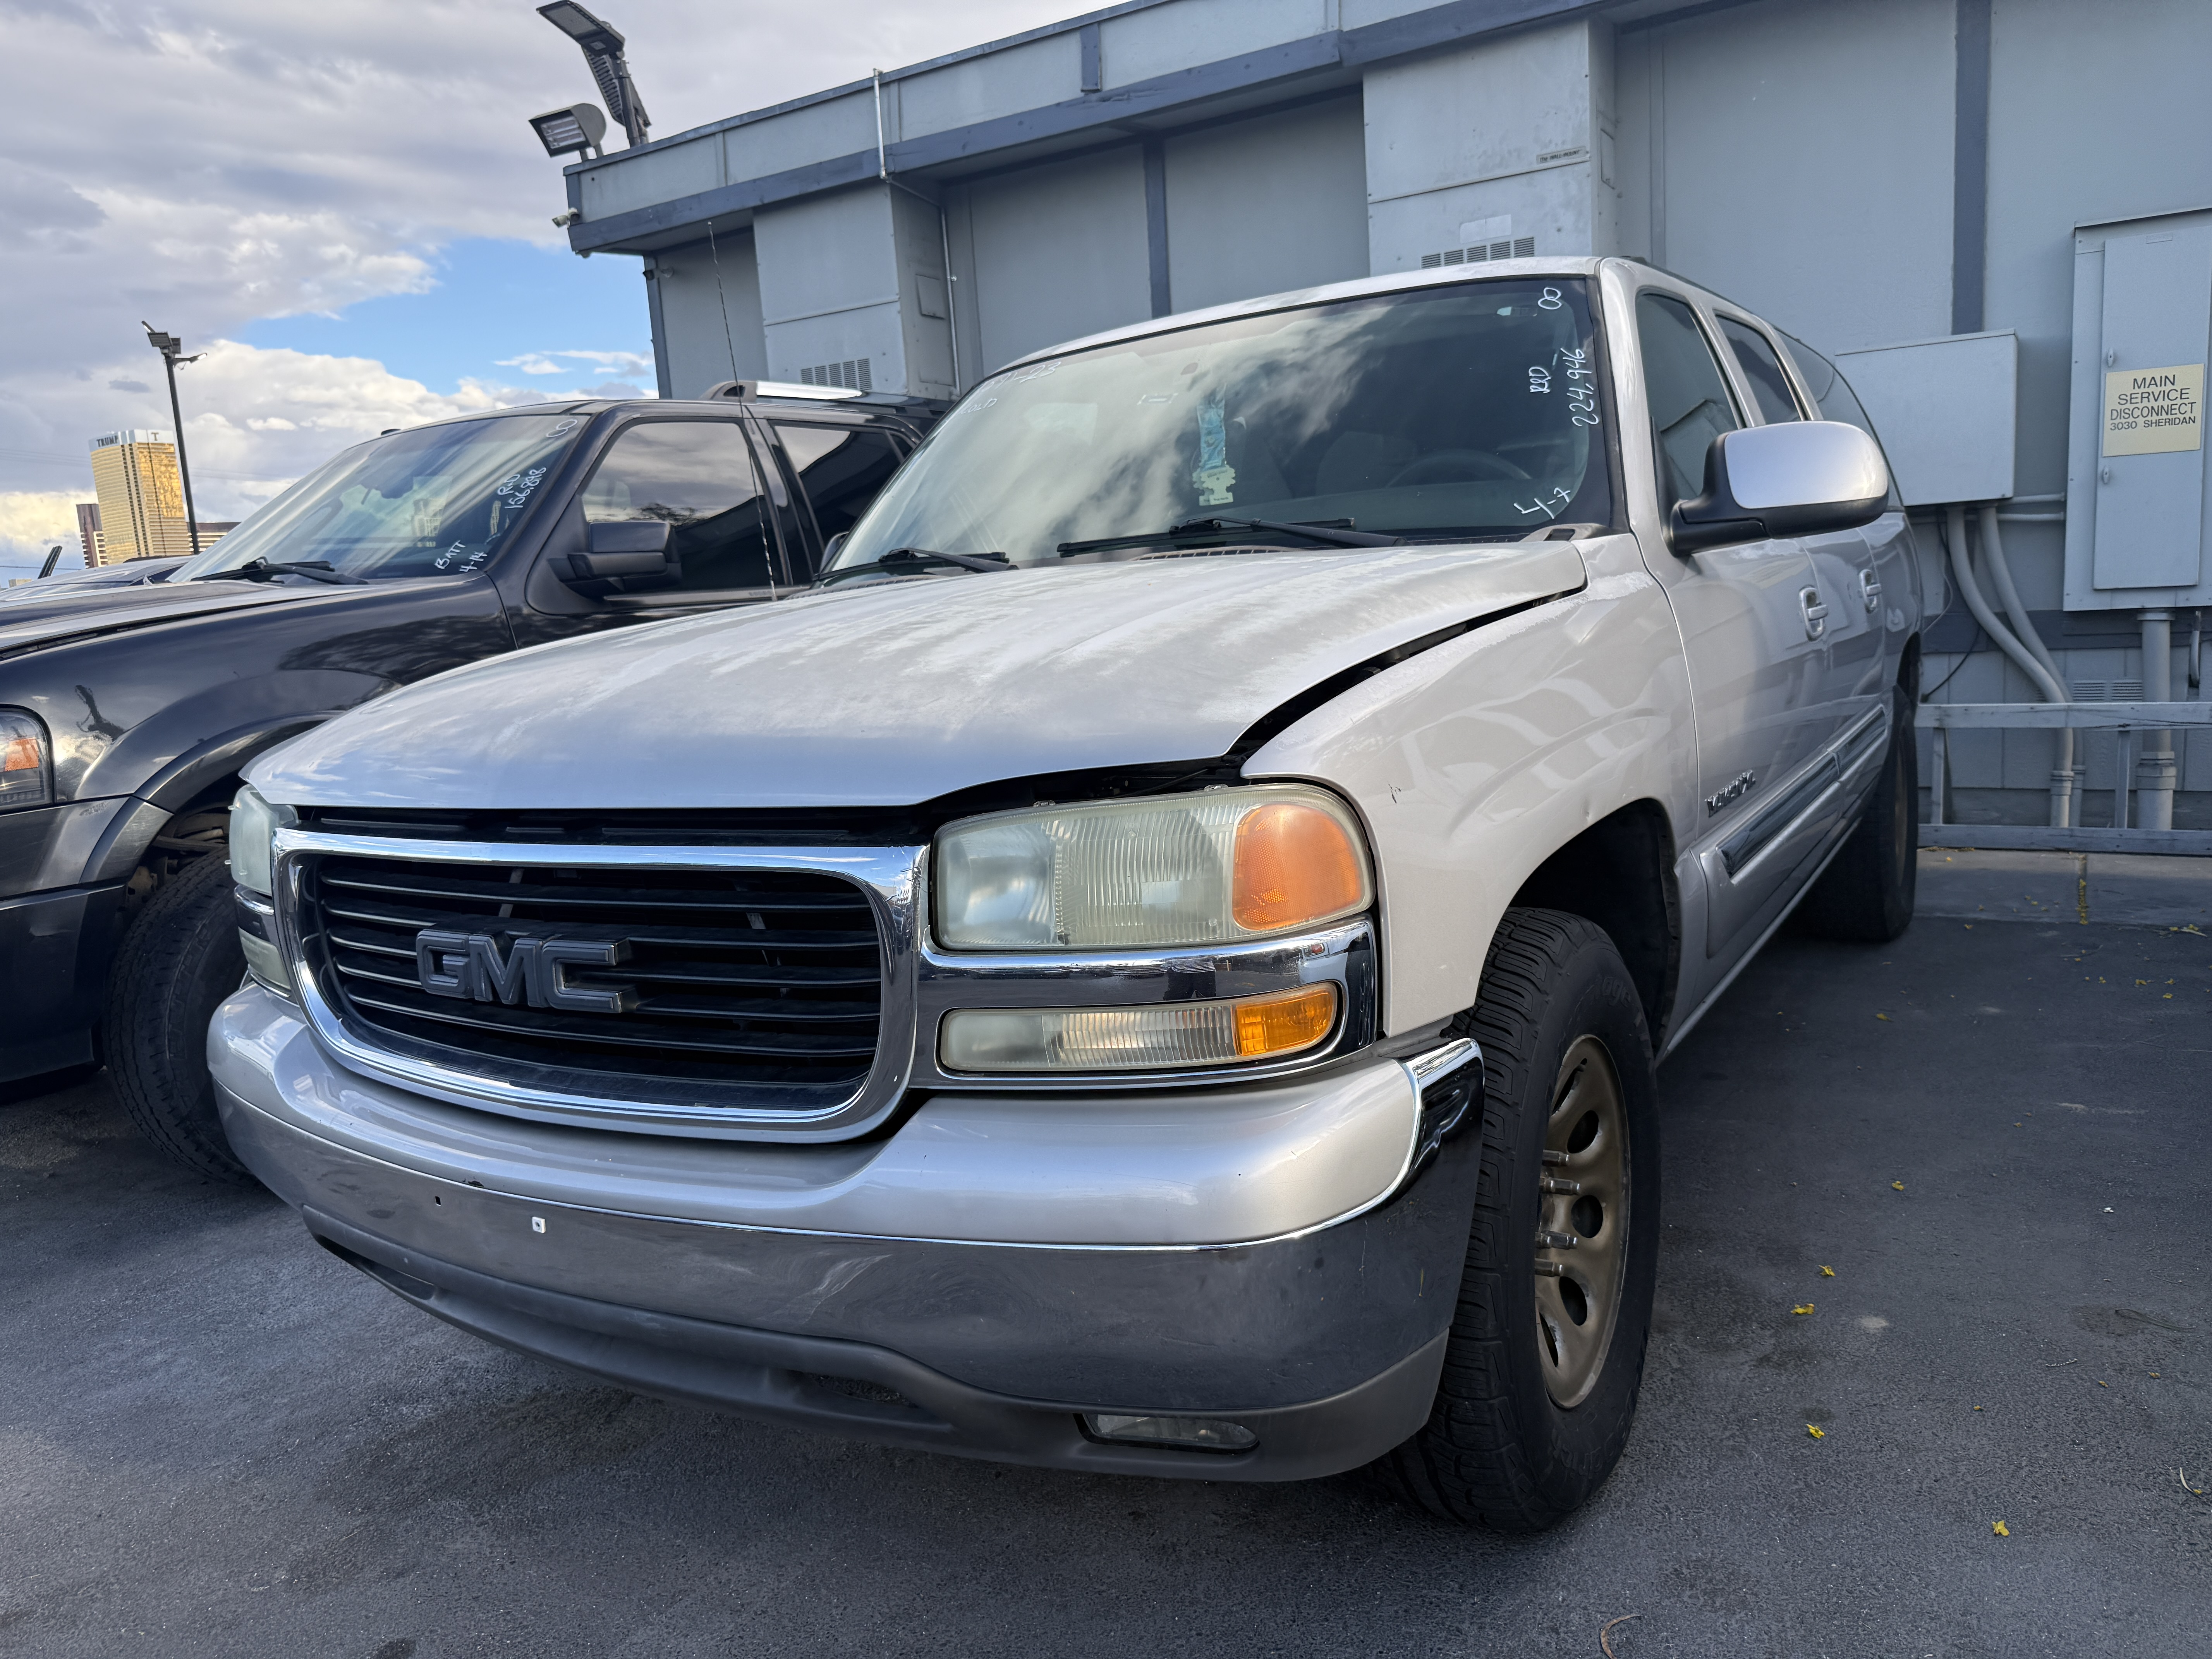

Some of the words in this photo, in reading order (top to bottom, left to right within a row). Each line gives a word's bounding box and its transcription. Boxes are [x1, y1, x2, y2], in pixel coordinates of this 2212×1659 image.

[1561, 347, 1599, 426] 224,946
[2133, 374, 2175, 390] MAIN
[2118, 388, 2190, 405] SERVICE
[2111, 402, 2196, 421] DISCONNECT
[2110, 421, 2137, 431] 3030
[2143, 416, 2196, 428] SHERIDAN
[96, 435, 118, 447] TRUMP
[151, 432, 159, 441] T
[1513, 487, 1571, 519] 4-7
[434, 540, 466, 569] BATT
[459, 551, 488, 572] 4-14
[416, 928, 622, 1013] GMC
